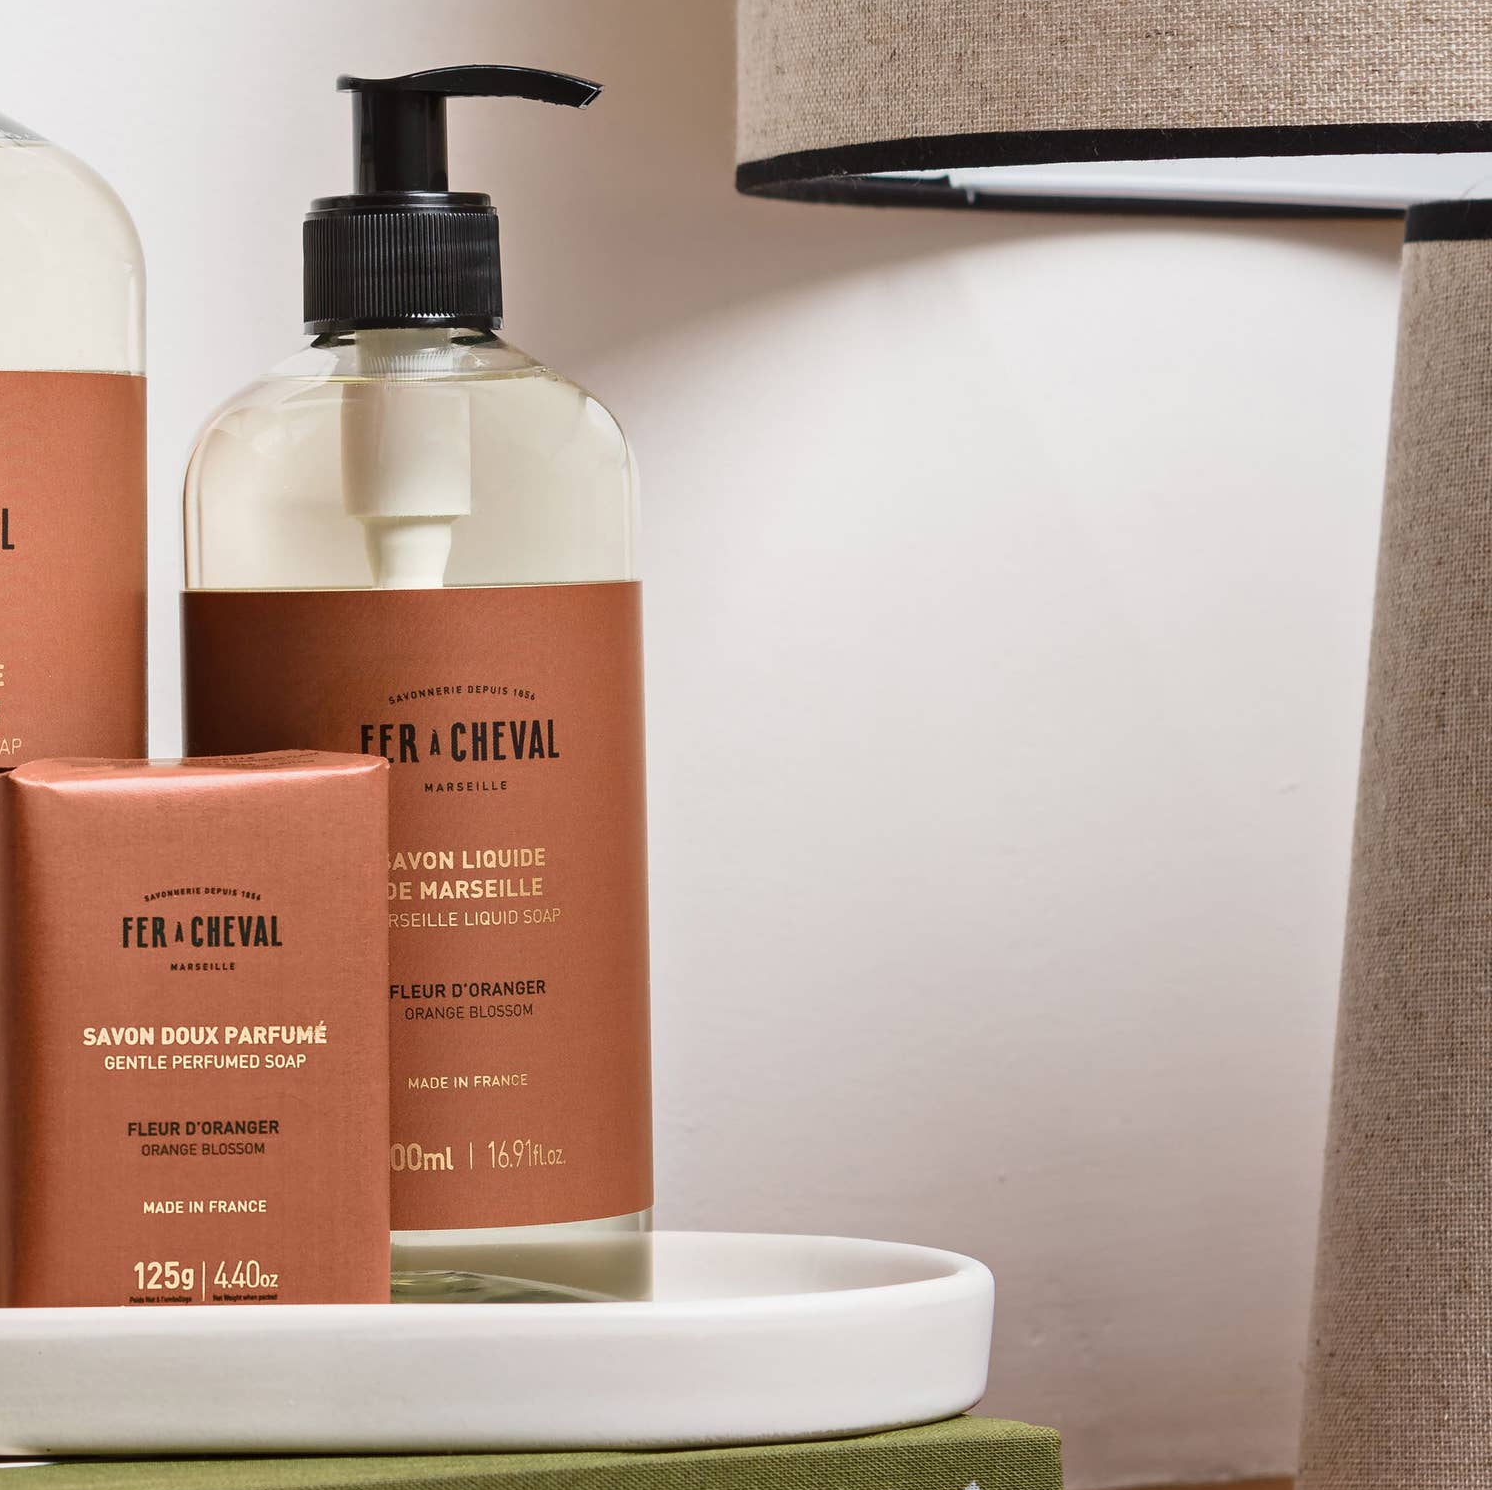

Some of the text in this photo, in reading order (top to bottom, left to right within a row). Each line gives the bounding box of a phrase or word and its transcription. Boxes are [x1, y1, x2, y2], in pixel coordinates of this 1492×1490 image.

[389, 685, 536, 705] SAVONNERIE DEPUIS 1856
[360, 719, 560, 764] FER À CHEVAL
[424, 780, 507, 792] MARSEILLE
[462, 848, 546, 870] LIQUIDE
[144, 887, 261, 902] SAVONNERIE DEPUIS 1856
[388, 878, 543, 900] DE MARSEILLE
[388, 908, 561, 928] RSEILLE LIQUID SOAP
[122, 915, 282, 948] FER À CHEVAL
[170, 962, 235, 971] MARSEILLE
[390, 980, 546, 999] FLEUR D'ORANGER
[405, 1003, 533, 1020] ORANGE BLOSSOM
[83, 1021, 327, 1046] SAVON DOUX PARFUMÉ
[104, 1054, 306, 1070] GENTLE PERFUMED SOAP
[408, 1074, 528, 1090] MADE IN FRANCE
[127, 1120, 279, 1137] FLEUR D'ORANGER
[141, 1142, 265, 1156] ORANGE BLOSSOM
[390, 1143, 454, 1171] 00ml
[143, 1199, 267, 1214] MADE IN FRANCE
[133, 1260, 278, 1290] 125g 4.40oz
